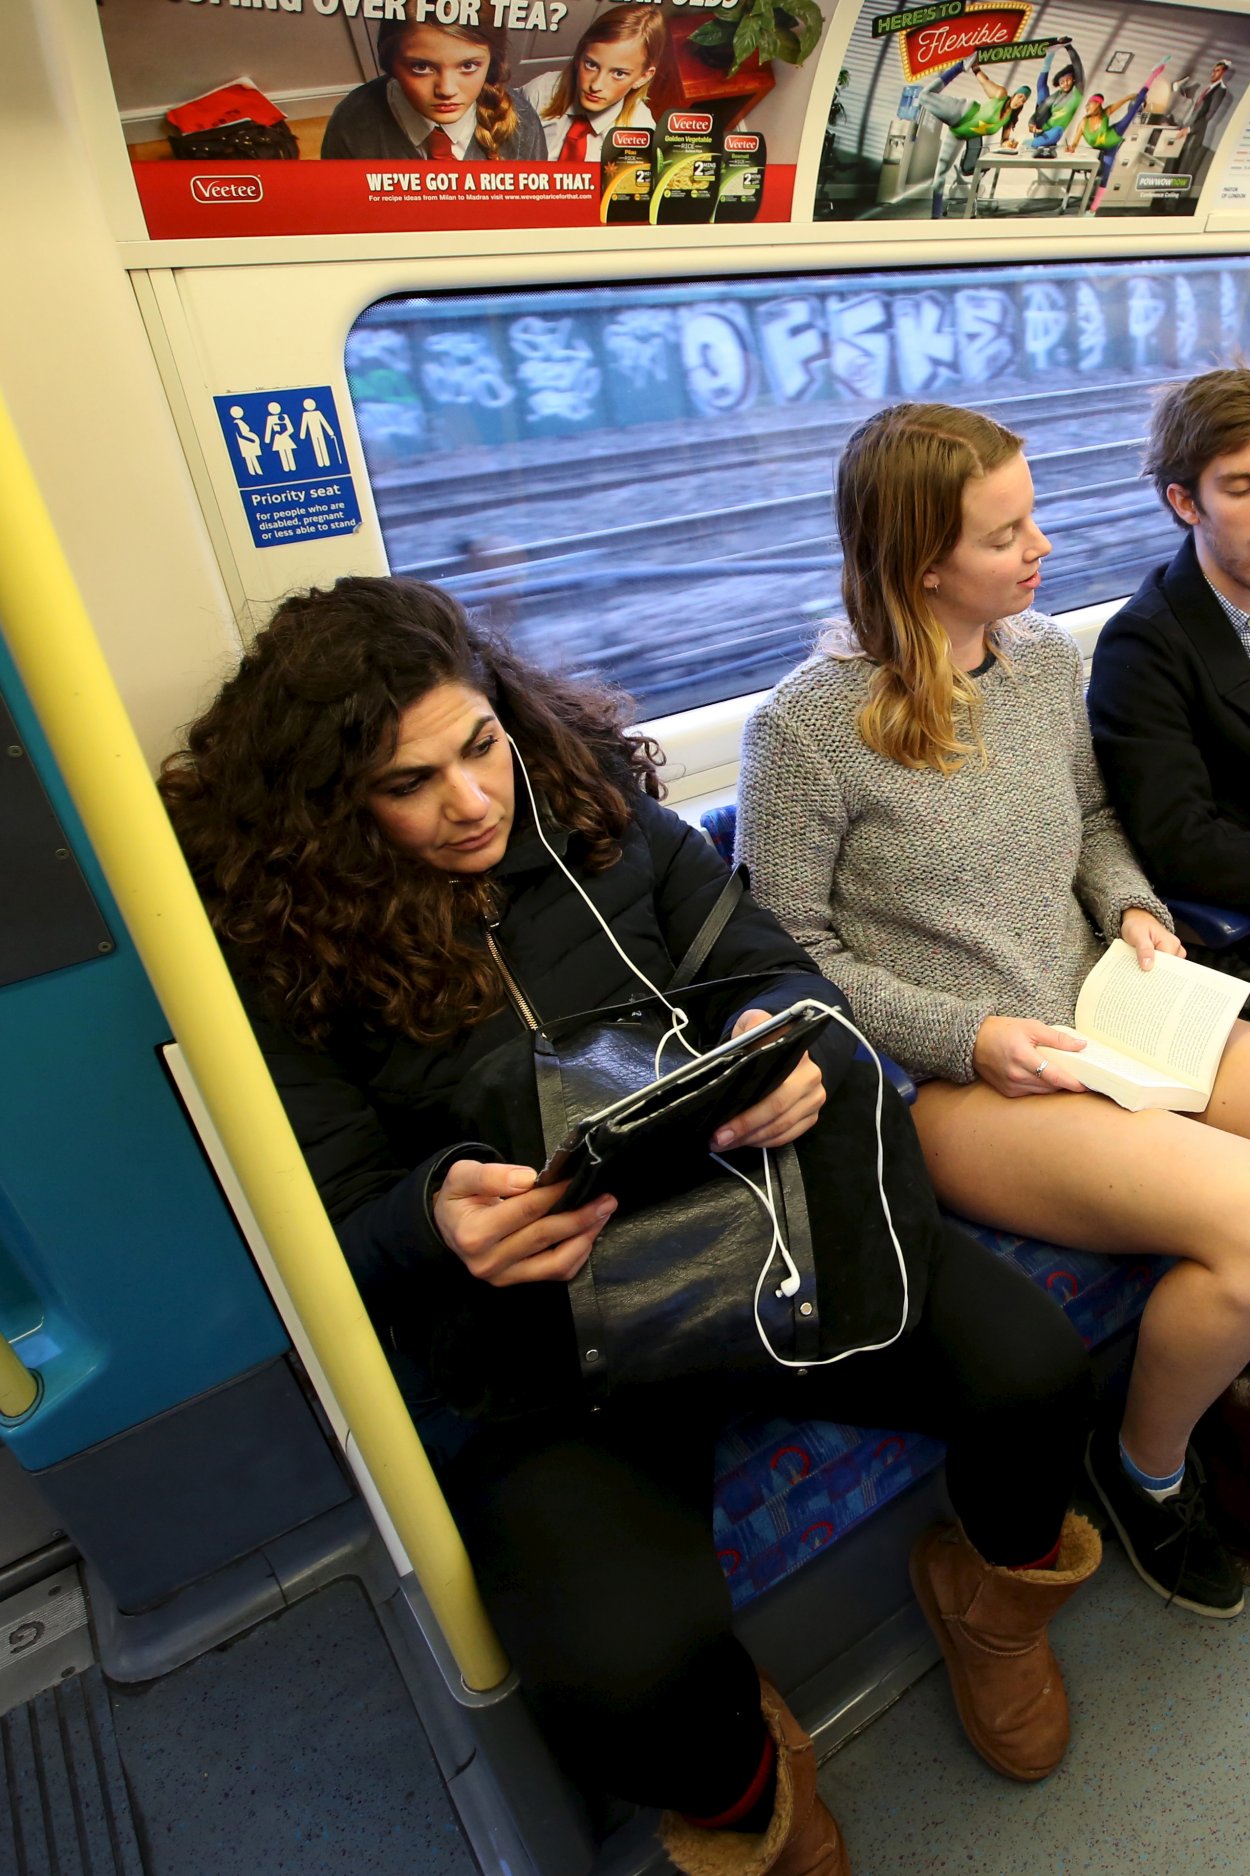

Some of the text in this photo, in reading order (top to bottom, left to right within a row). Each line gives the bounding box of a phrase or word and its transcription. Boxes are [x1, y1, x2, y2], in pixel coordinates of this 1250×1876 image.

[313, 0, 406, 20] OVER
[416, 0, 479, 26] FOR
[491, 1, 568, 31] TEA?
[877, 2, 961, 33] HERE'S TO
[917, 23, 1008, 63] Flexible
[978, 42, 1050, 62] WORKING
[672, 116, 709, 130] Veetee
[616, 133, 647, 145] Veetee
[685, 136, 712, 144] Vegetable
[728, 138, 756, 149] Veetee
[636, 170, 645, 183] 2
[694, 161, 704, 176] 2
[366, 173, 595, 191] WE'VE GOT A RICE FOR THAT.
[743, 173, 752, 185] 2
[195, 179, 257, 198] Veetee
[251, 484, 341, 506] Priority seat
[256, 502, 345, 521] for people who are
[303, 511, 345, 525] pregnant
[261, 518, 357, 540] or less able to stand
